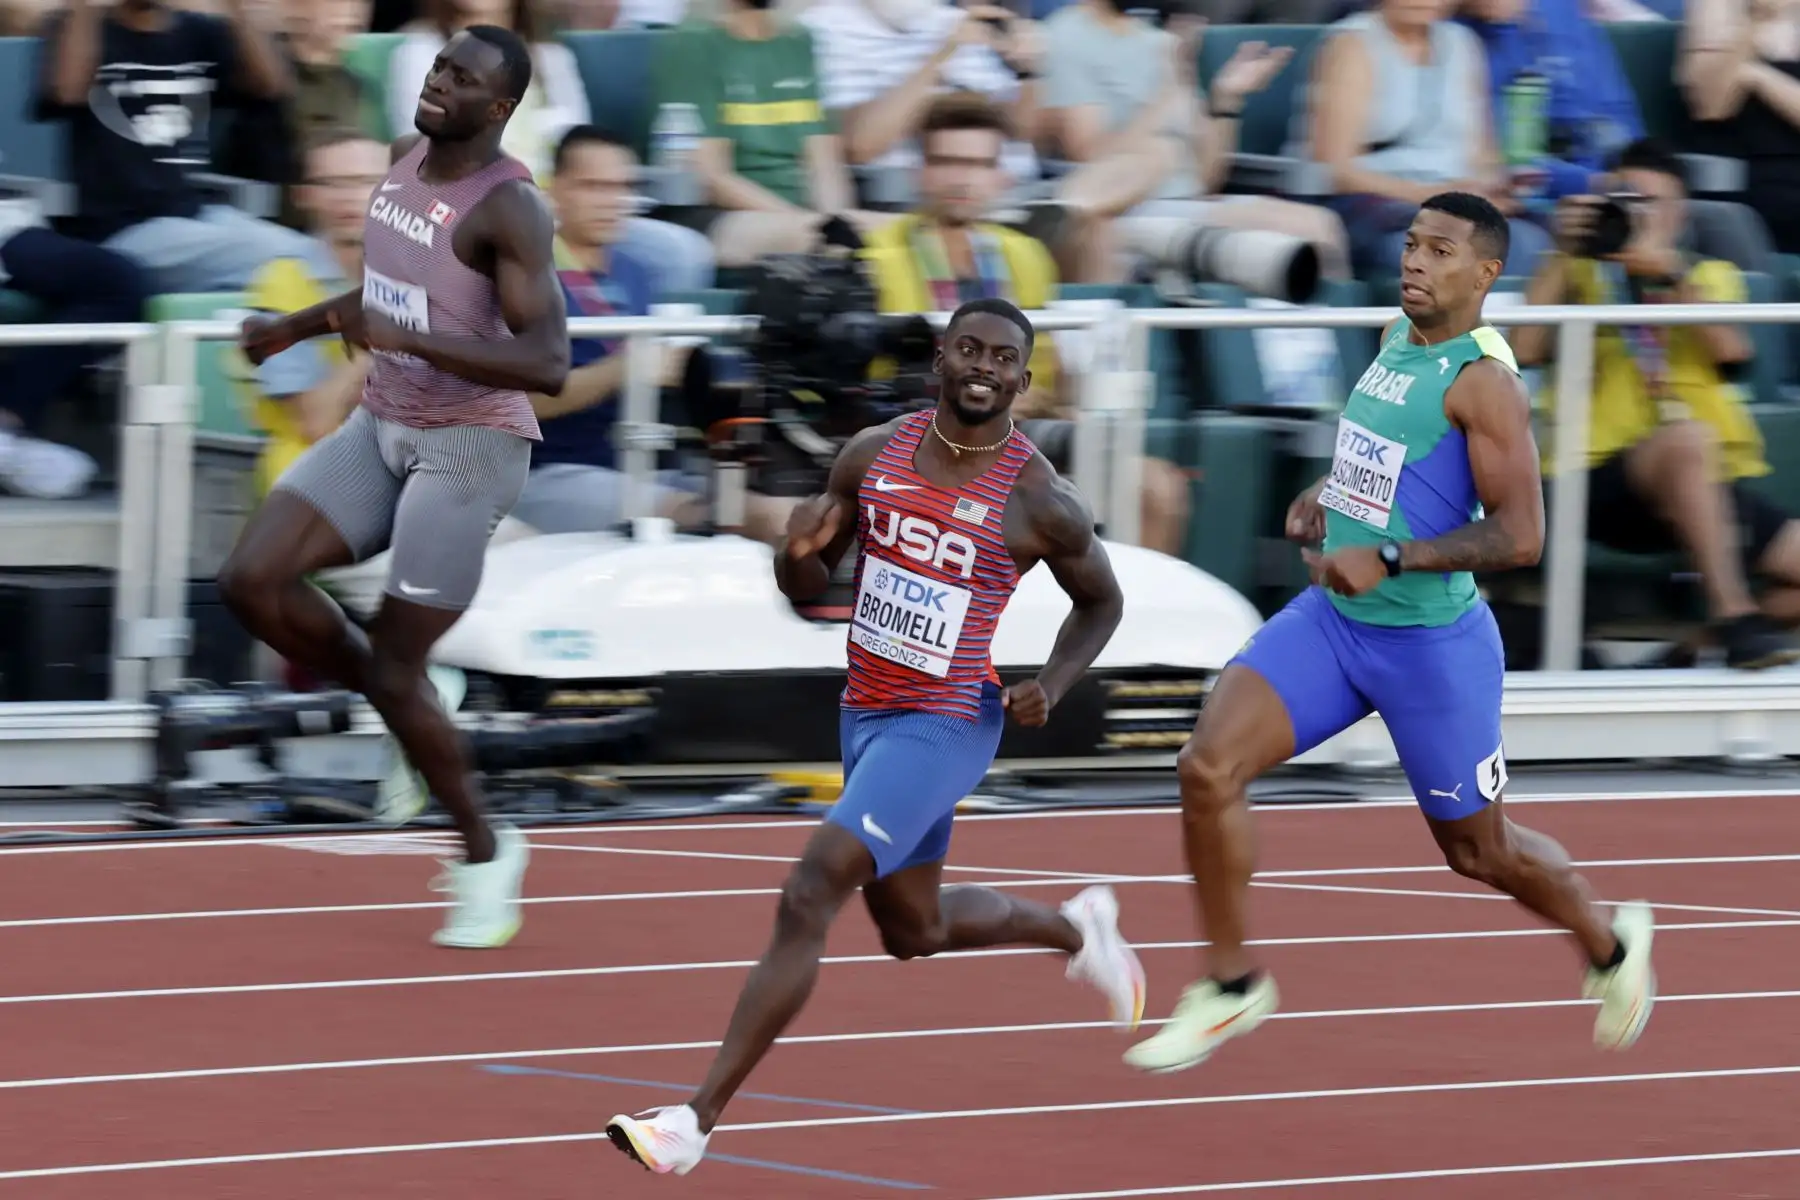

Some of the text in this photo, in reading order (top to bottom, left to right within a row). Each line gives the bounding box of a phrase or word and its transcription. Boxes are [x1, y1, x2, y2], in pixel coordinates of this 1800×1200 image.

[370, 196, 435, 249] CANADA
[371, 279, 410, 311] TDK
[1355, 361, 1416, 406] BRASIL
[1349, 431, 1389, 466] TDK
[867, 504, 976, 579] USA
[890, 572, 950, 613] TDK
[859, 591, 948, 649] BROMELL
[860, 632, 929, 669] OREGON22
[1491, 754, 1500, 793] 5
